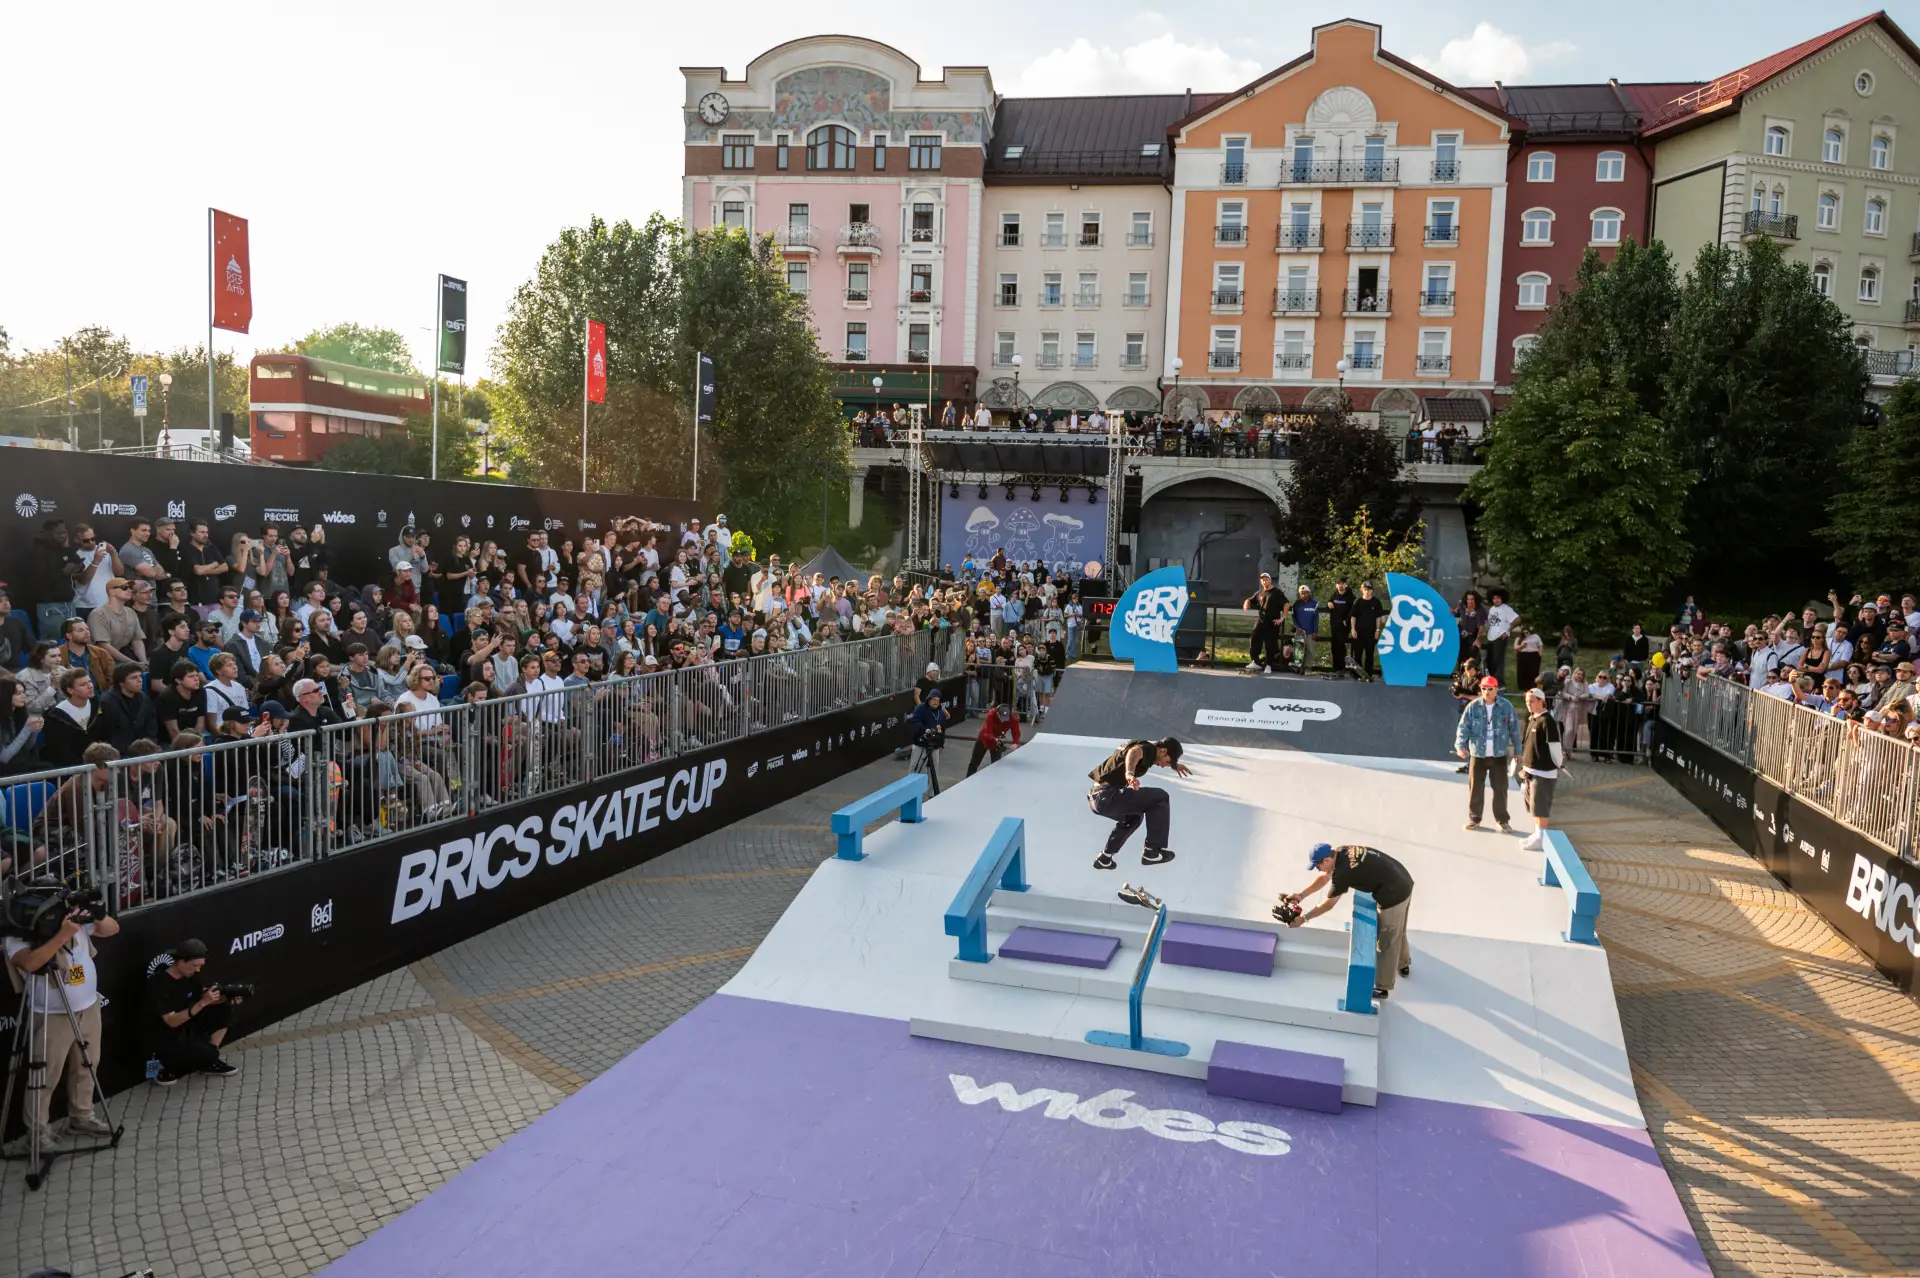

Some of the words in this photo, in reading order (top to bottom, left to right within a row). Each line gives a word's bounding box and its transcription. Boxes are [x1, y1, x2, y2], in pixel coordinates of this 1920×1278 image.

[446, 320, 466, 332] GST
[92, 503, 119, 515] АПР
[215, 507, 236, 518] GST
[1134, 586, 1189, 617] BRI
[1385, 594, 1435, 628] CS
[1400, 623, 1444, 653] Cup
[391, 816, 543, 924] BRICS
[546, 776, 666, 865] SKATE
[666, 758, 727, 821] CUP
[230, 931, 262, 955] АПР
